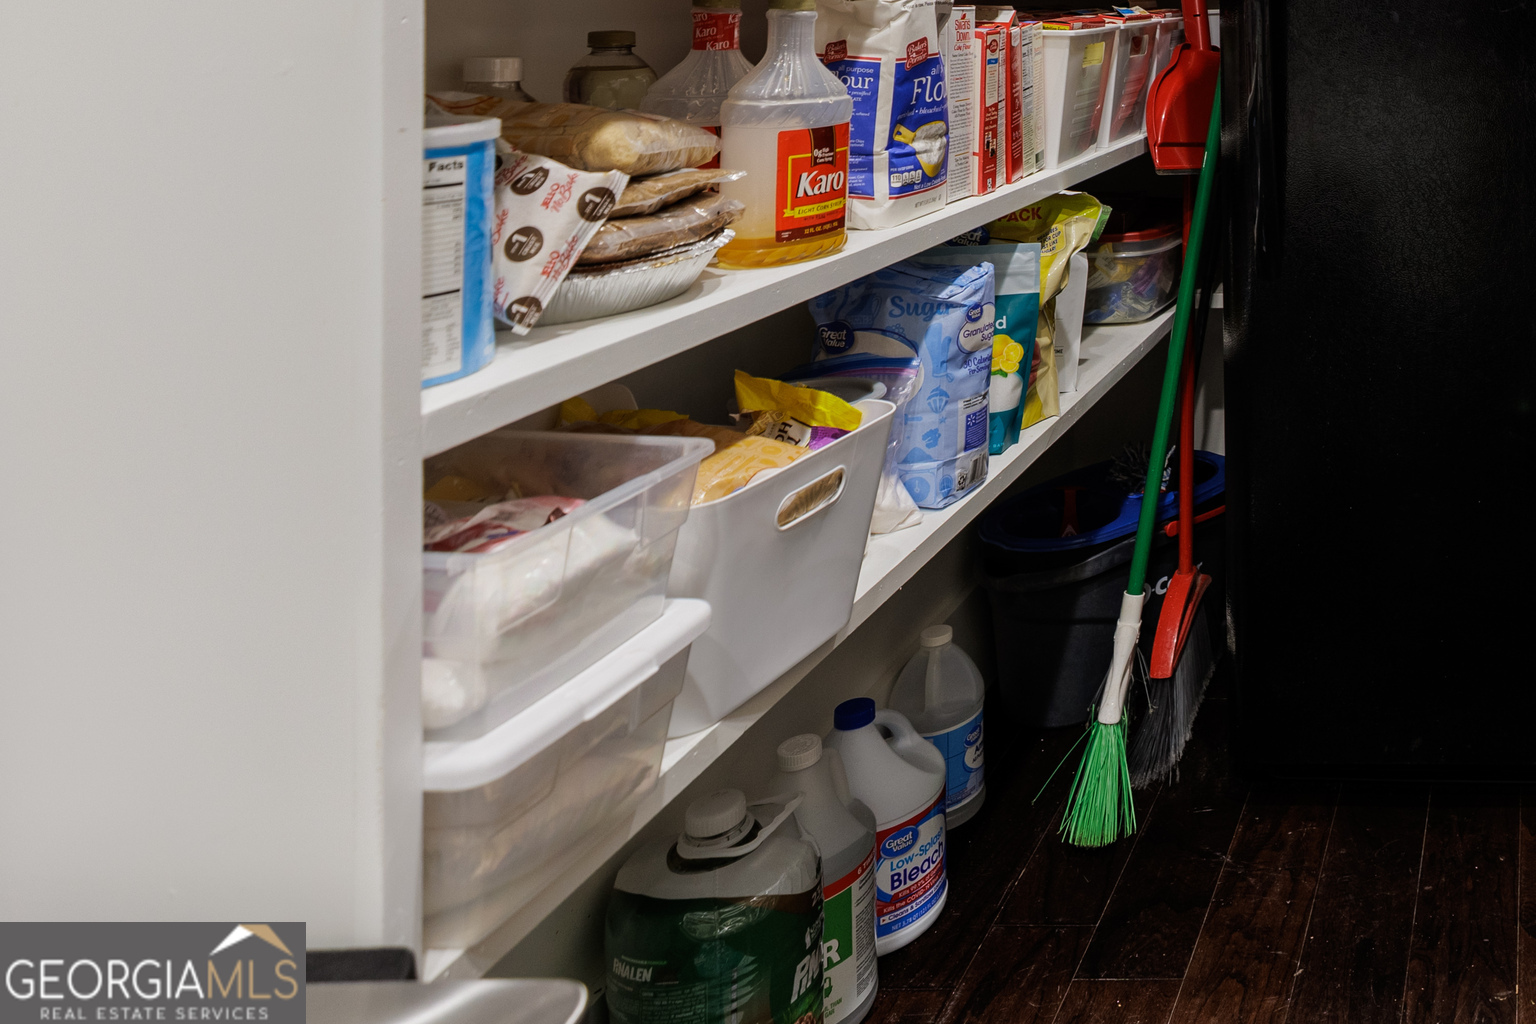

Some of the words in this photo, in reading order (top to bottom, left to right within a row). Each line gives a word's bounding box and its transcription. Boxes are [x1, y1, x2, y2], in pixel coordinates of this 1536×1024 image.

[796, 170, 845, 198] Karo
[888, 296, 952, 320] Sugar
[886, 831, 912, 849] Great
[892, 839, 912, 852] Value
[890, 841, 943, 891] Bleach
